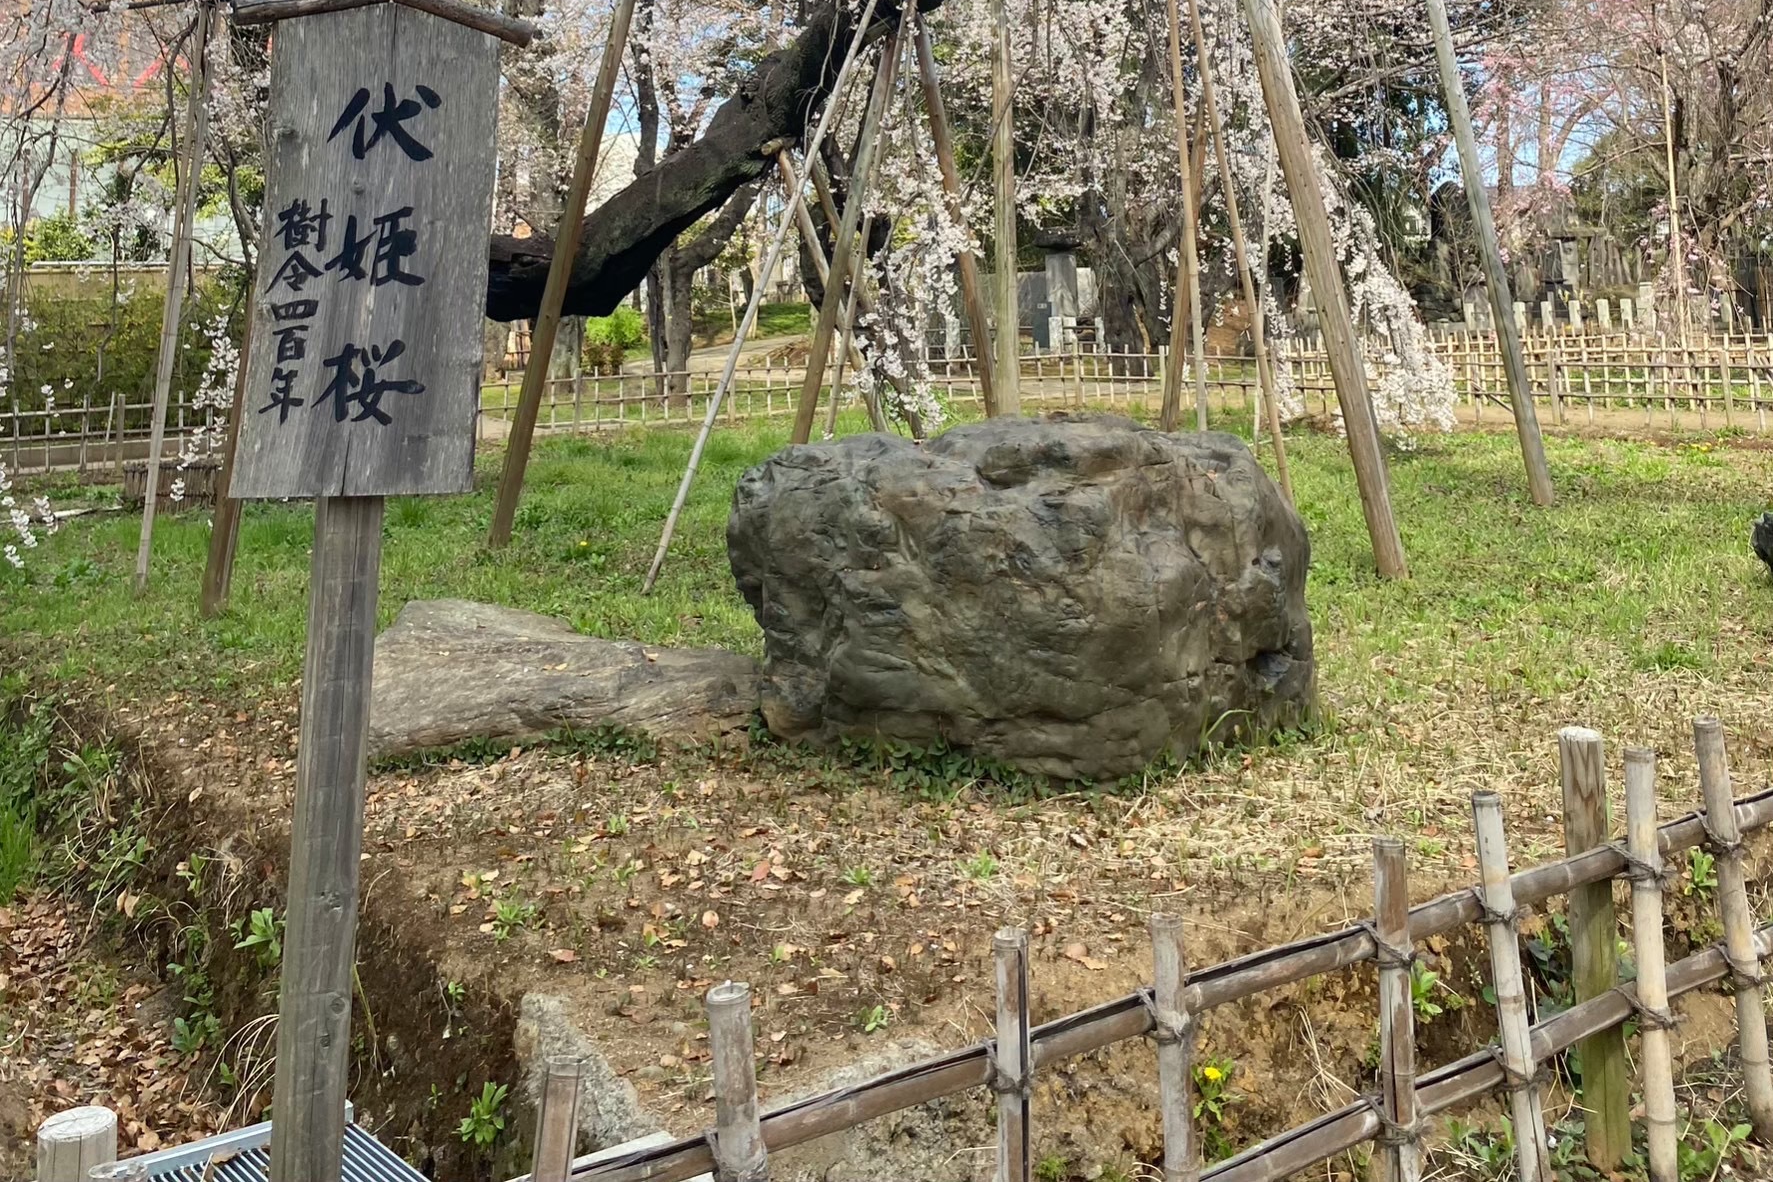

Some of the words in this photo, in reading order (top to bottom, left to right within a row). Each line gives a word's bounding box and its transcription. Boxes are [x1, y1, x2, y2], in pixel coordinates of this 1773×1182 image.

[258, 197, 334, 426] 樹令四百年
[311, 81, 443, 427] 伏姫桜
